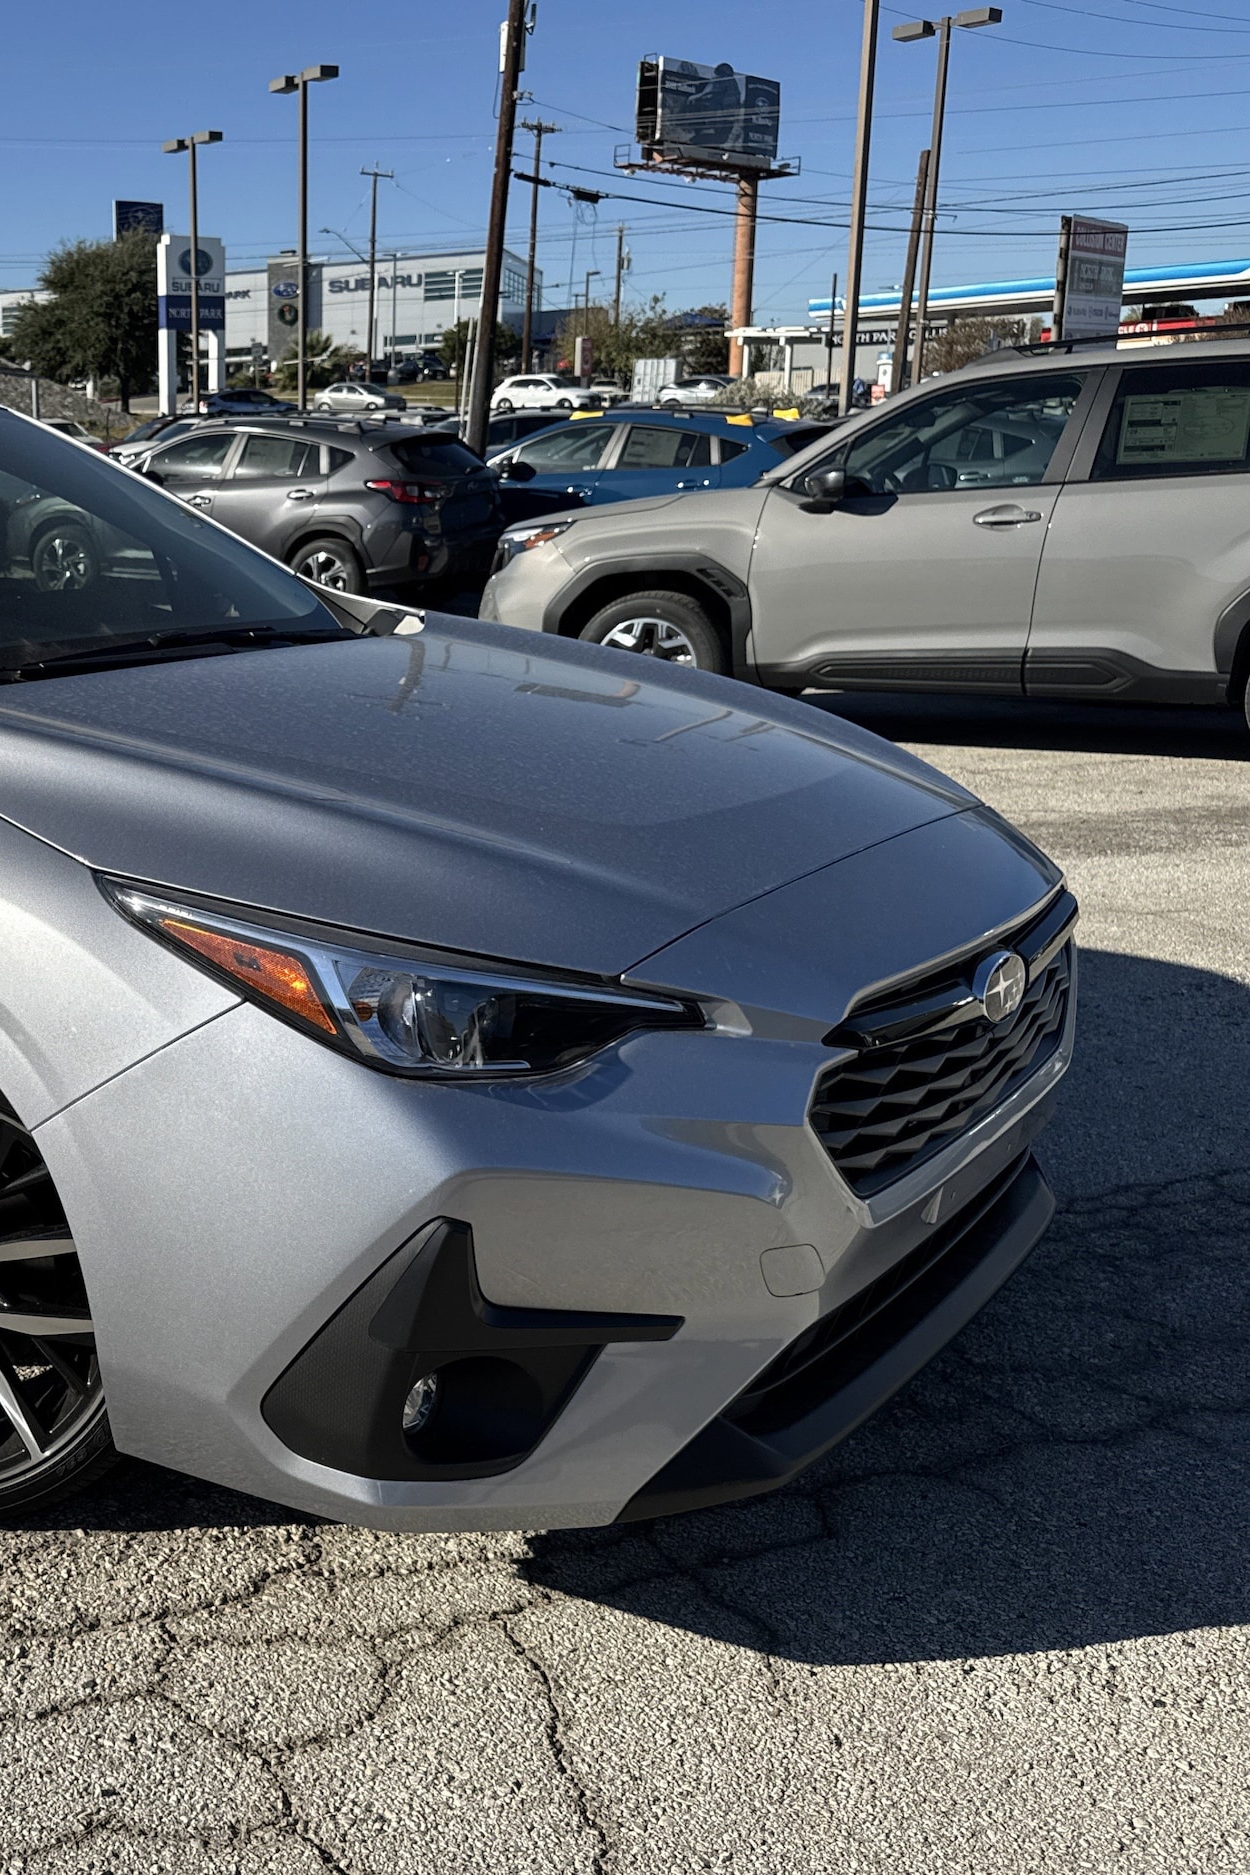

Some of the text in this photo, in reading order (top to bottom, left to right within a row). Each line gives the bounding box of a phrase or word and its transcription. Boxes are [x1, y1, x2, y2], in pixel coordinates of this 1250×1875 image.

[1104, 230, 1125, 253] CENTER
[328, 273, 423, 293] SUBARU
[225, 290, 251, 300] ARK
[168, 307, 224, 319] NORT PARK
[1118, 323, 1135, 335] CLE
[831, 332, 870, 345] NOTH
[872, 331, 897, 343] PAR
